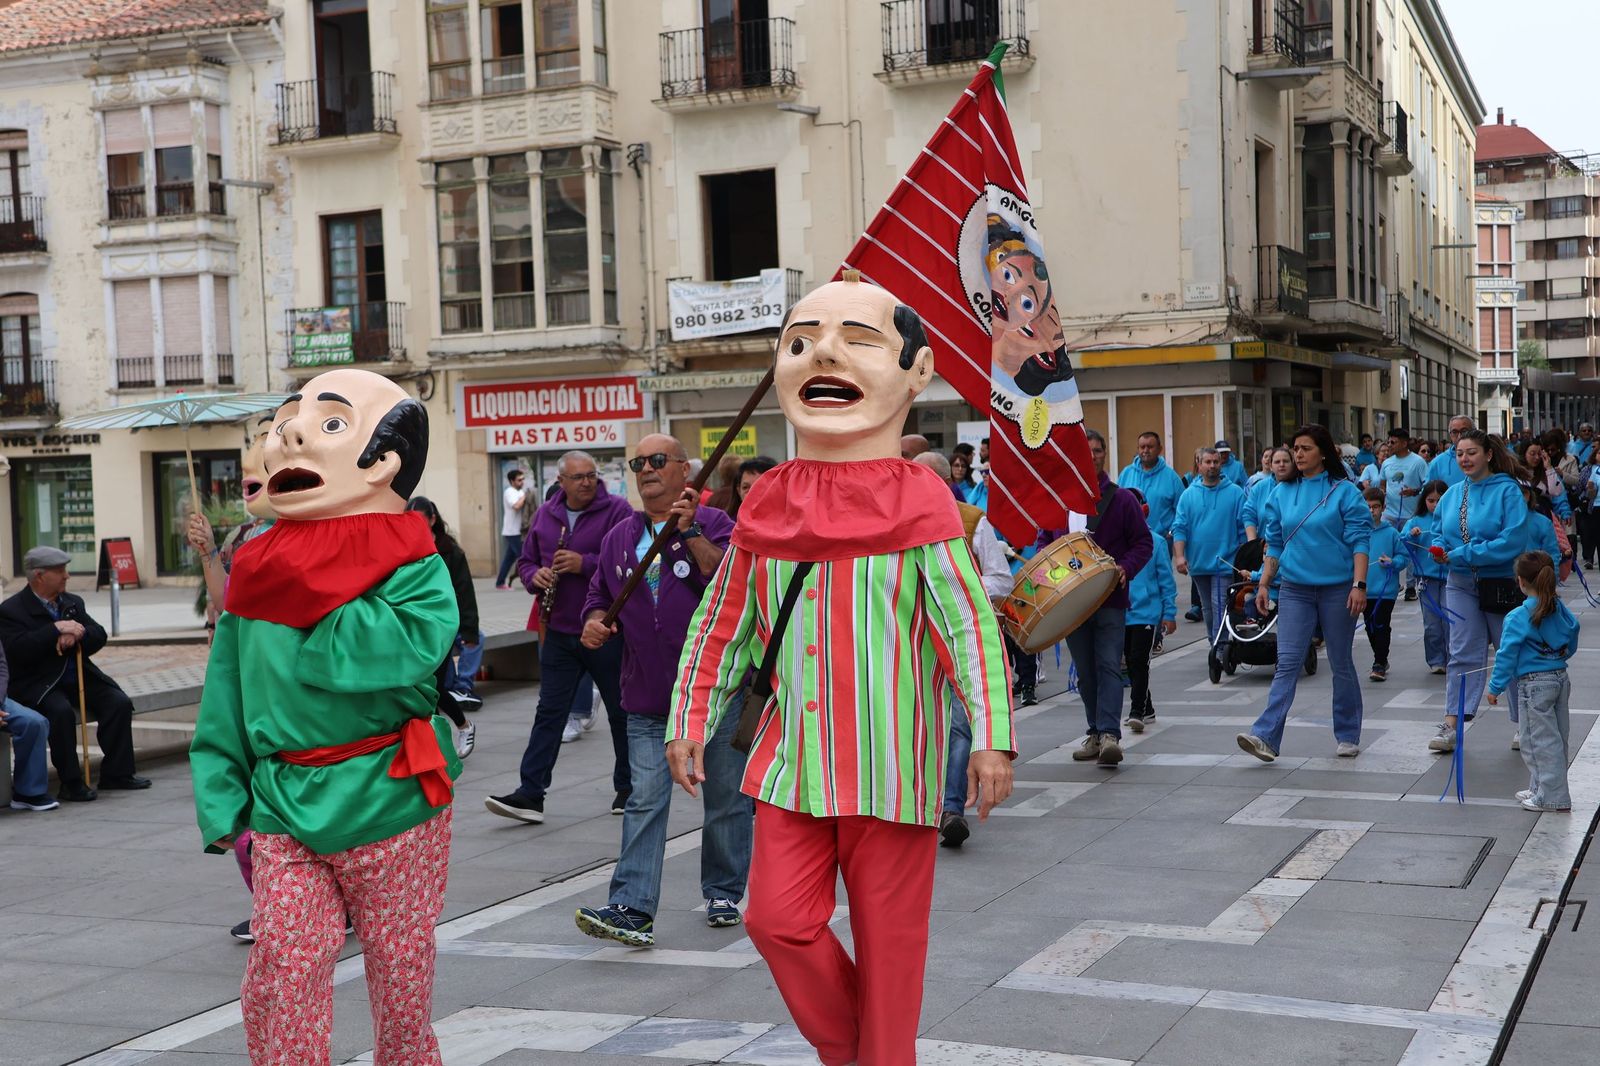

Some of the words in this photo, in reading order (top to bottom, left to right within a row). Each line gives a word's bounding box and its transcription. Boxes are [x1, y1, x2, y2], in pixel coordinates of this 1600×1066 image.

[691, 302, 721, 313] VENTA
[723, 300, 735, 309] DE
[738, 296, 764, 307] PISOS
[675, 314, 706, 329] 980
[711, 309, 745, 324] 982
[751, 303, 782, 319] 303
[640, 375, 697, 390] MATERIAL
[702, 377, 733, 388] PARA
[470, 384, 581, 420] LIQUIDACIÓN
[584, 384, 638, 413] TOTAL
[1, 436, 37, 448] YVES
[43, 433, 101, 446] ROCHER
[494, 428, 568, 446] HASTA
